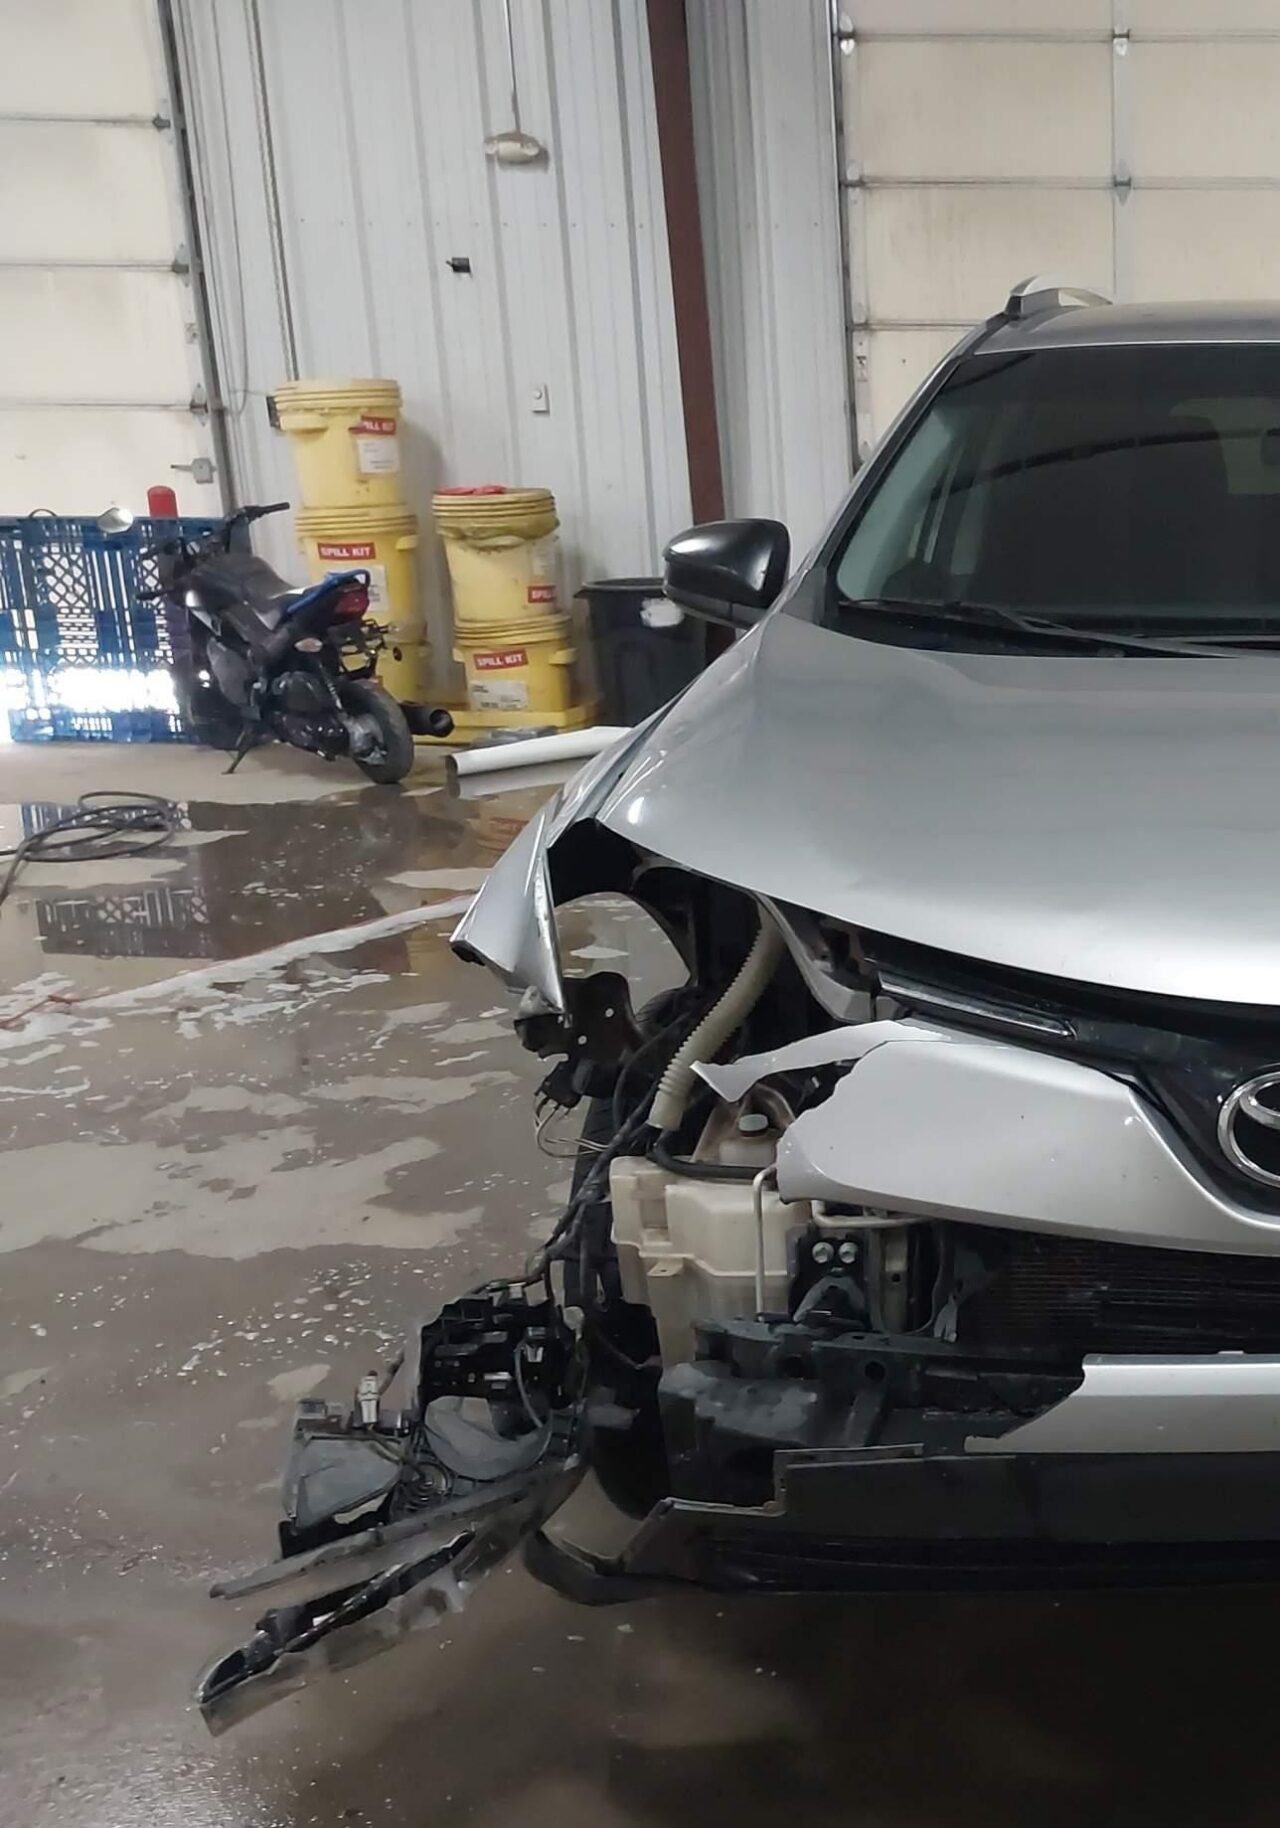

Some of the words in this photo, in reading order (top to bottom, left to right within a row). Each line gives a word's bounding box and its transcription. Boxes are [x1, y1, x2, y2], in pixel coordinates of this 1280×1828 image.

[320, 547, 350, 557] SPILL
[352, 546, 371, 557] KIT
[477, 656, 504, 666] SPILL
[505, 653, 523, 665] KIT
